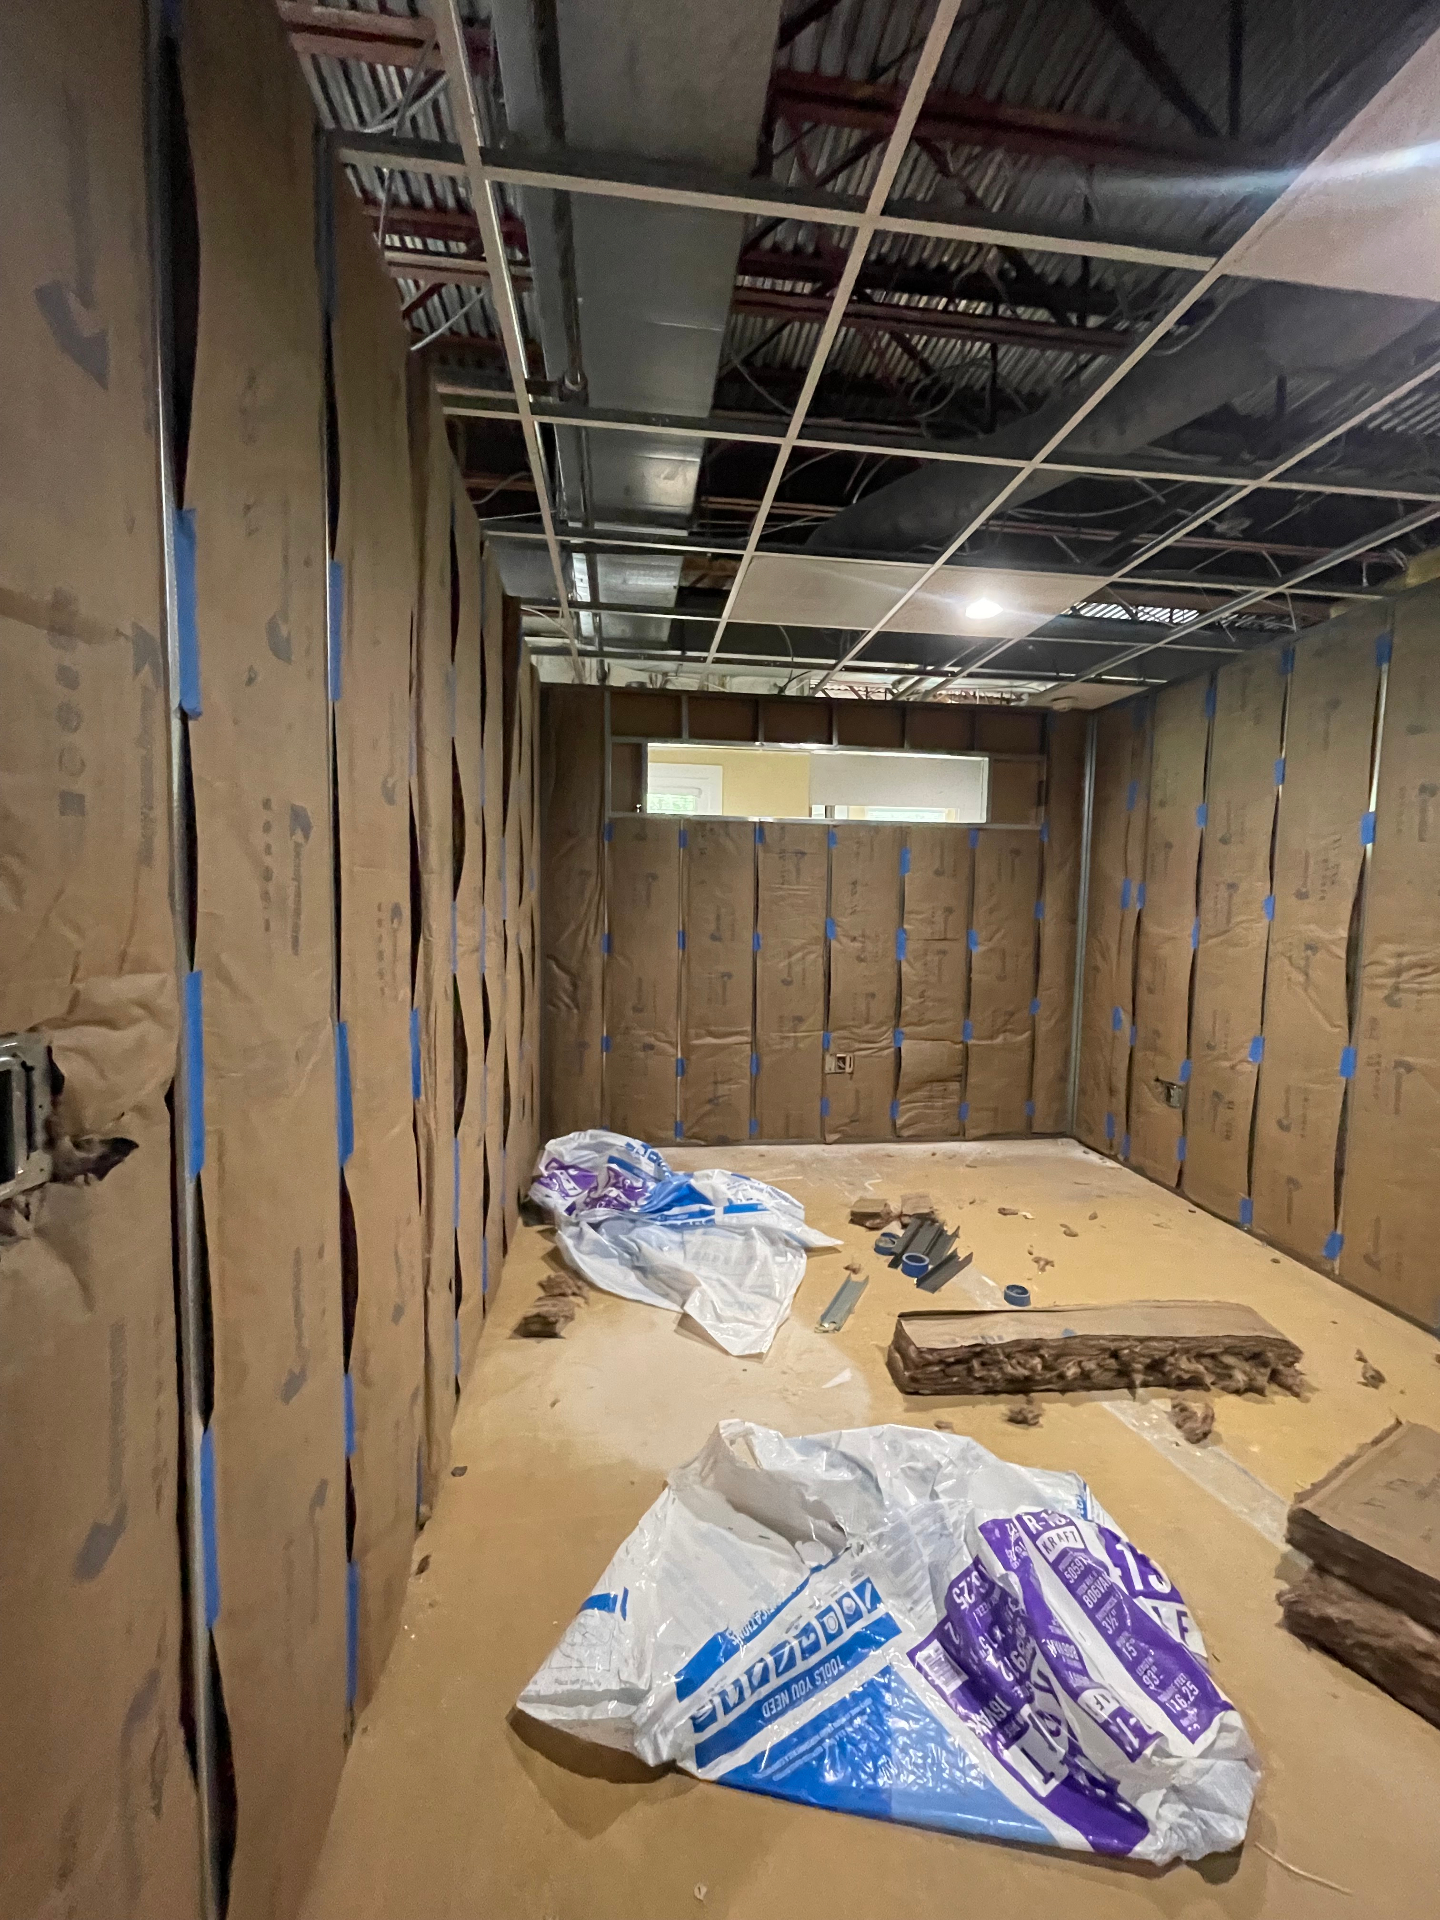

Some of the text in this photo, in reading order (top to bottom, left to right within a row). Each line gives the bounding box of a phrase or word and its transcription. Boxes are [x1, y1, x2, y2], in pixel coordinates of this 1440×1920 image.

[1041, 1530, 1078, 1554] KRAFT
[761, 1655, 845, 1718] TOOLS YOU NEED
